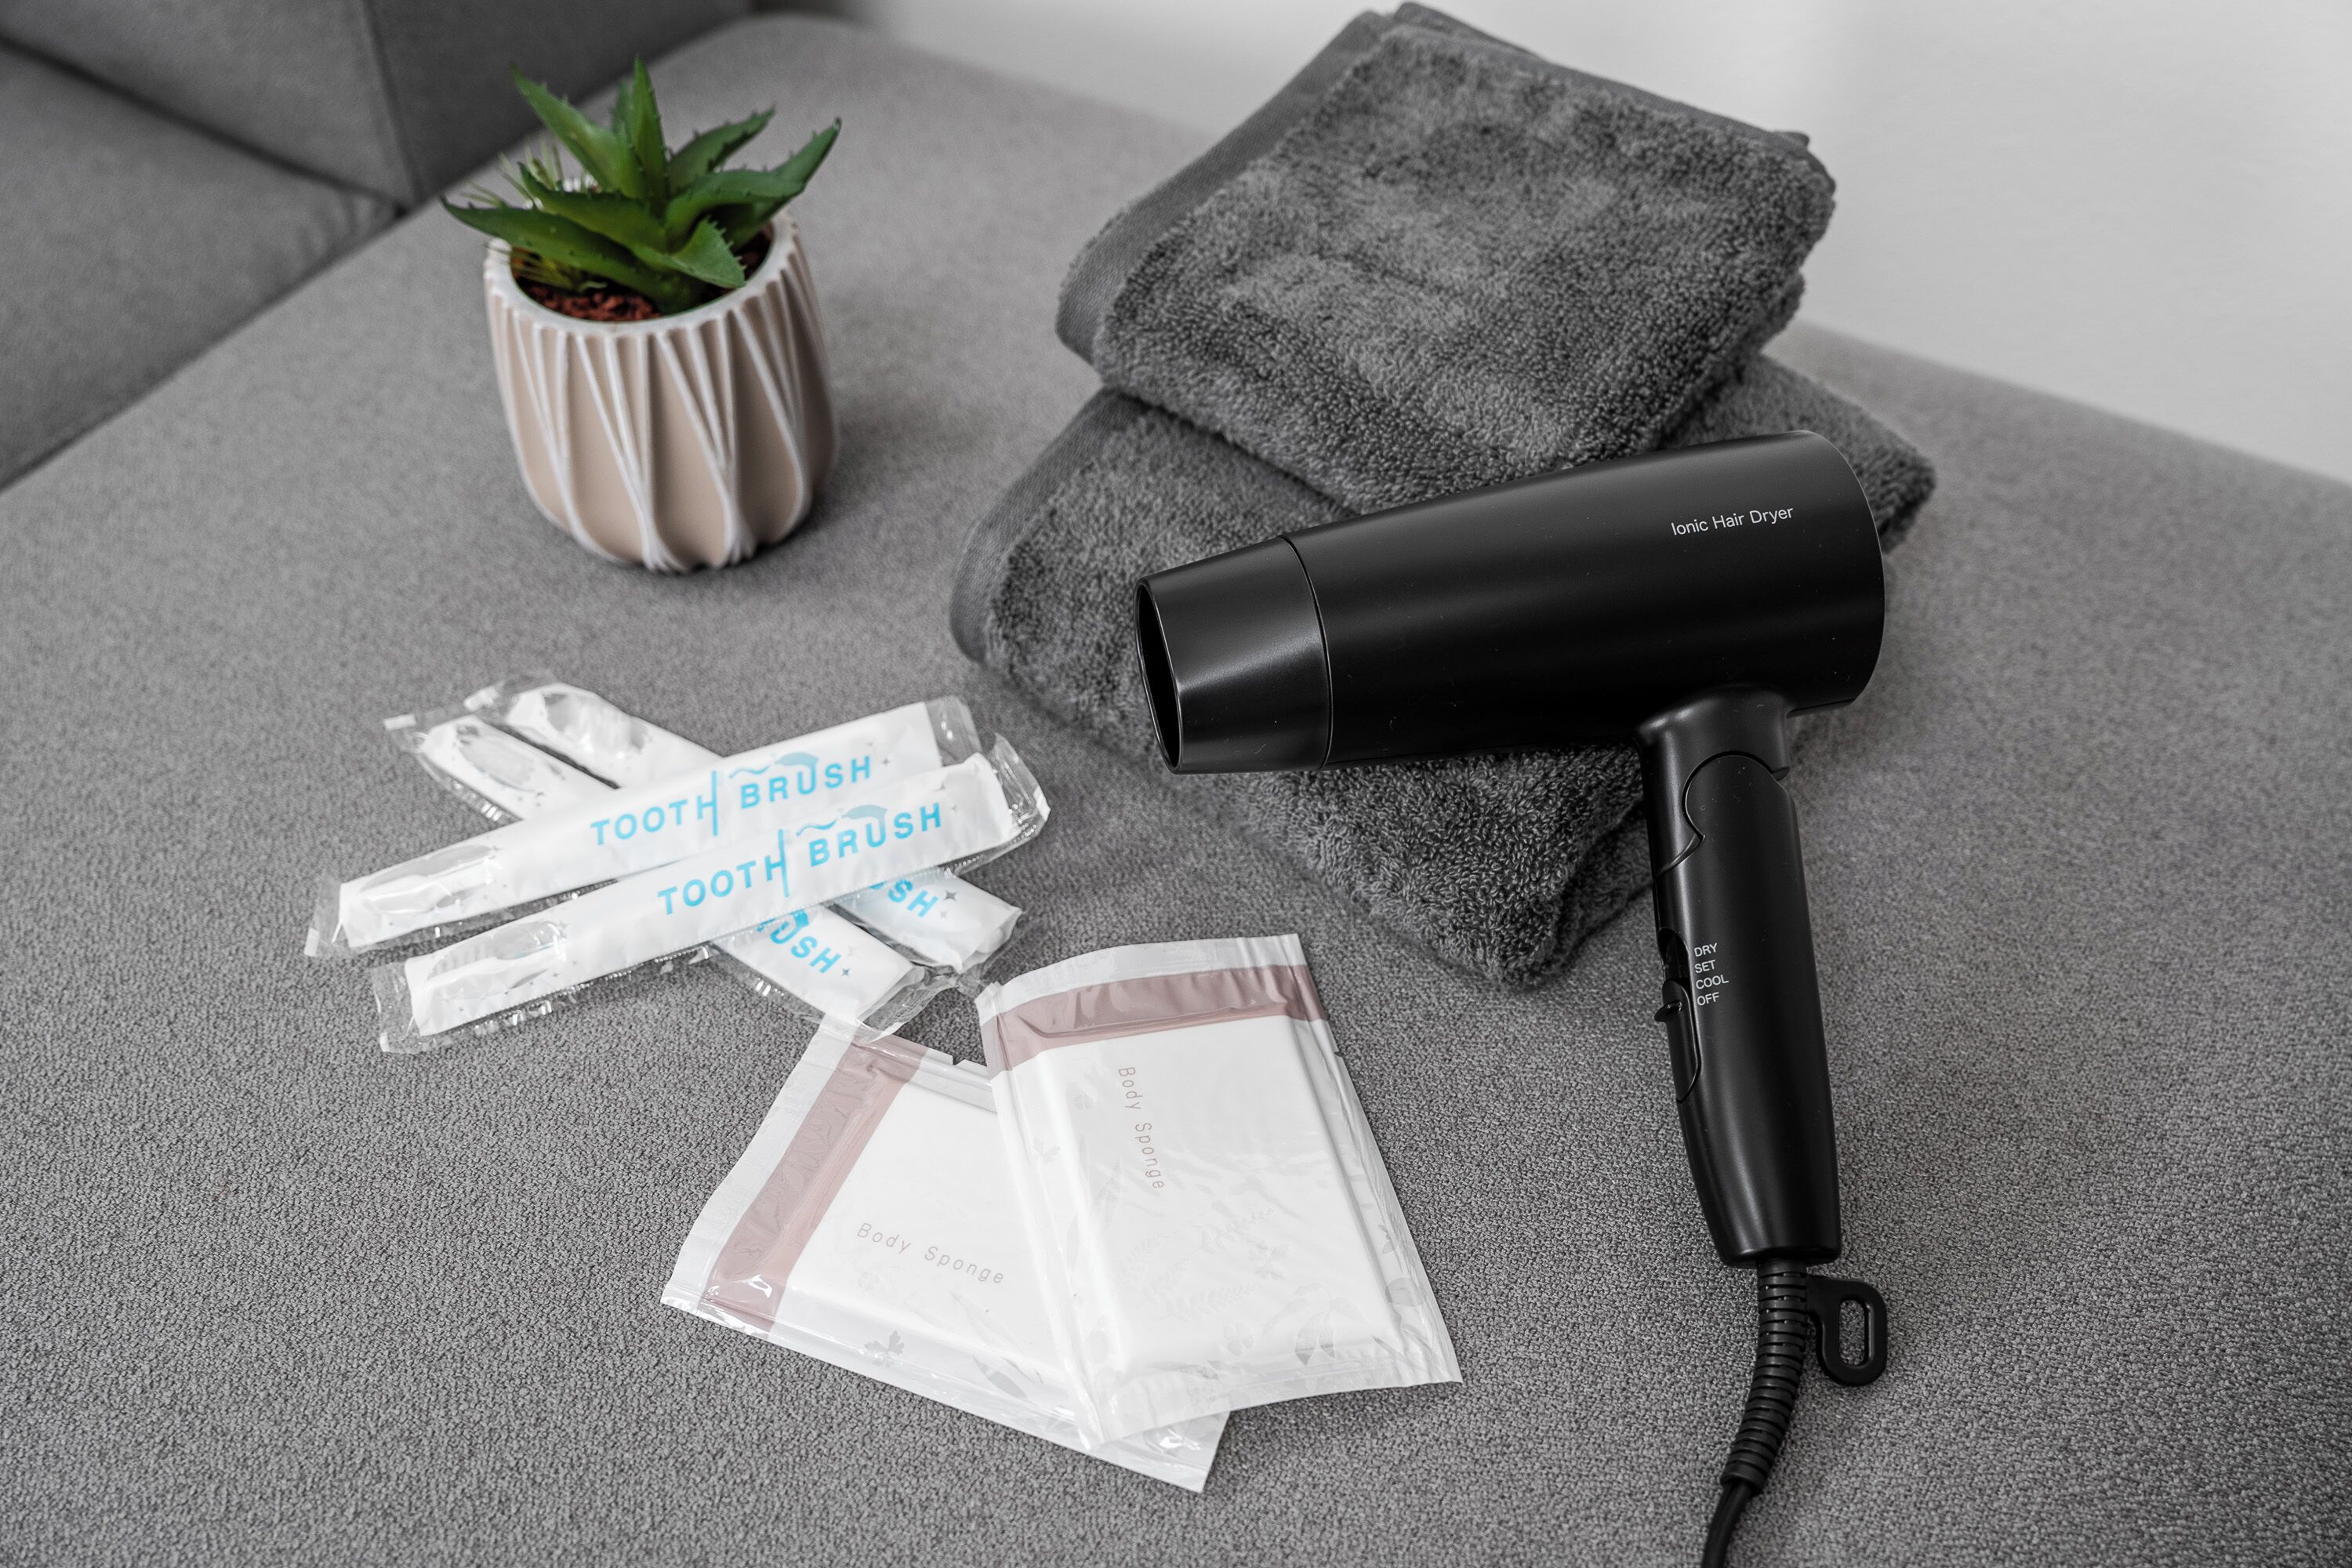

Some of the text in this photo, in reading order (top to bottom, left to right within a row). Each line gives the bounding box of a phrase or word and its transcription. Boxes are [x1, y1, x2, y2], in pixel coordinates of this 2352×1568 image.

[1671, 507, 1794, 535] Ionic Hair Dryer
[590, 754, 871, 846] TOOTH BRUSH
[657, 802, 942, 916] TOOTH BRUSH
[868, 879, 939, 918] SH
[1693, 942, 1718, 957] DRY
[1693, 959, 1716, 974] SET
[1695, 975, 1730, 989] COOL
[1697, 992, 1719, 1006] OFF
[1118, 1066, 1164, 1189] Body Sponge
[856, 1222, 1004, 1283] Body Sponge
